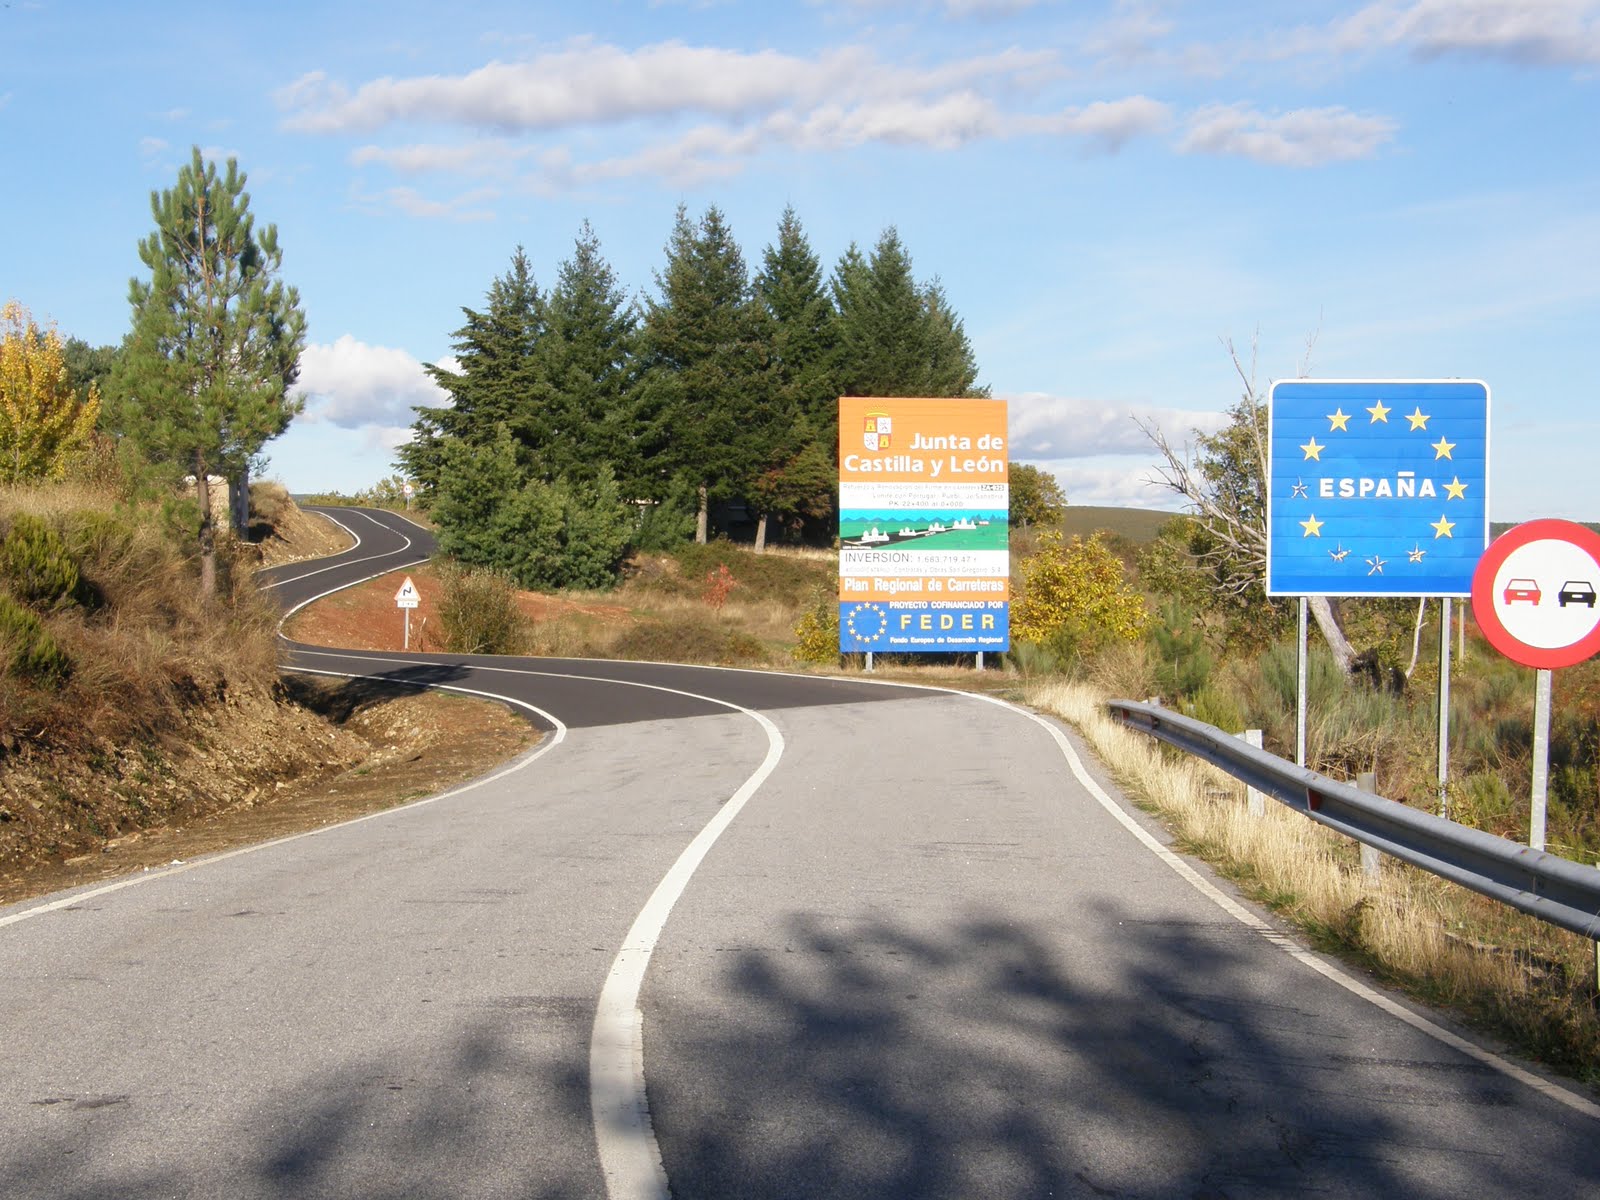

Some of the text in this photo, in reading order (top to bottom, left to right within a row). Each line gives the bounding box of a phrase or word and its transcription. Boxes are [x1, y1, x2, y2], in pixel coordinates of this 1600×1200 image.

[909, 432, 1004, 450] Junta de
[844, 455, 1004, 478] Castilla y León
[1319, 471, 1437, 498] ESPAÑA
[844, 578, 1004, 594] Plan Regional de Carreteras
[900, 614, 994, 630] FEDER
[910, 637, 935, 645] Europeo
[978, 637, 1004, 645] Regional
